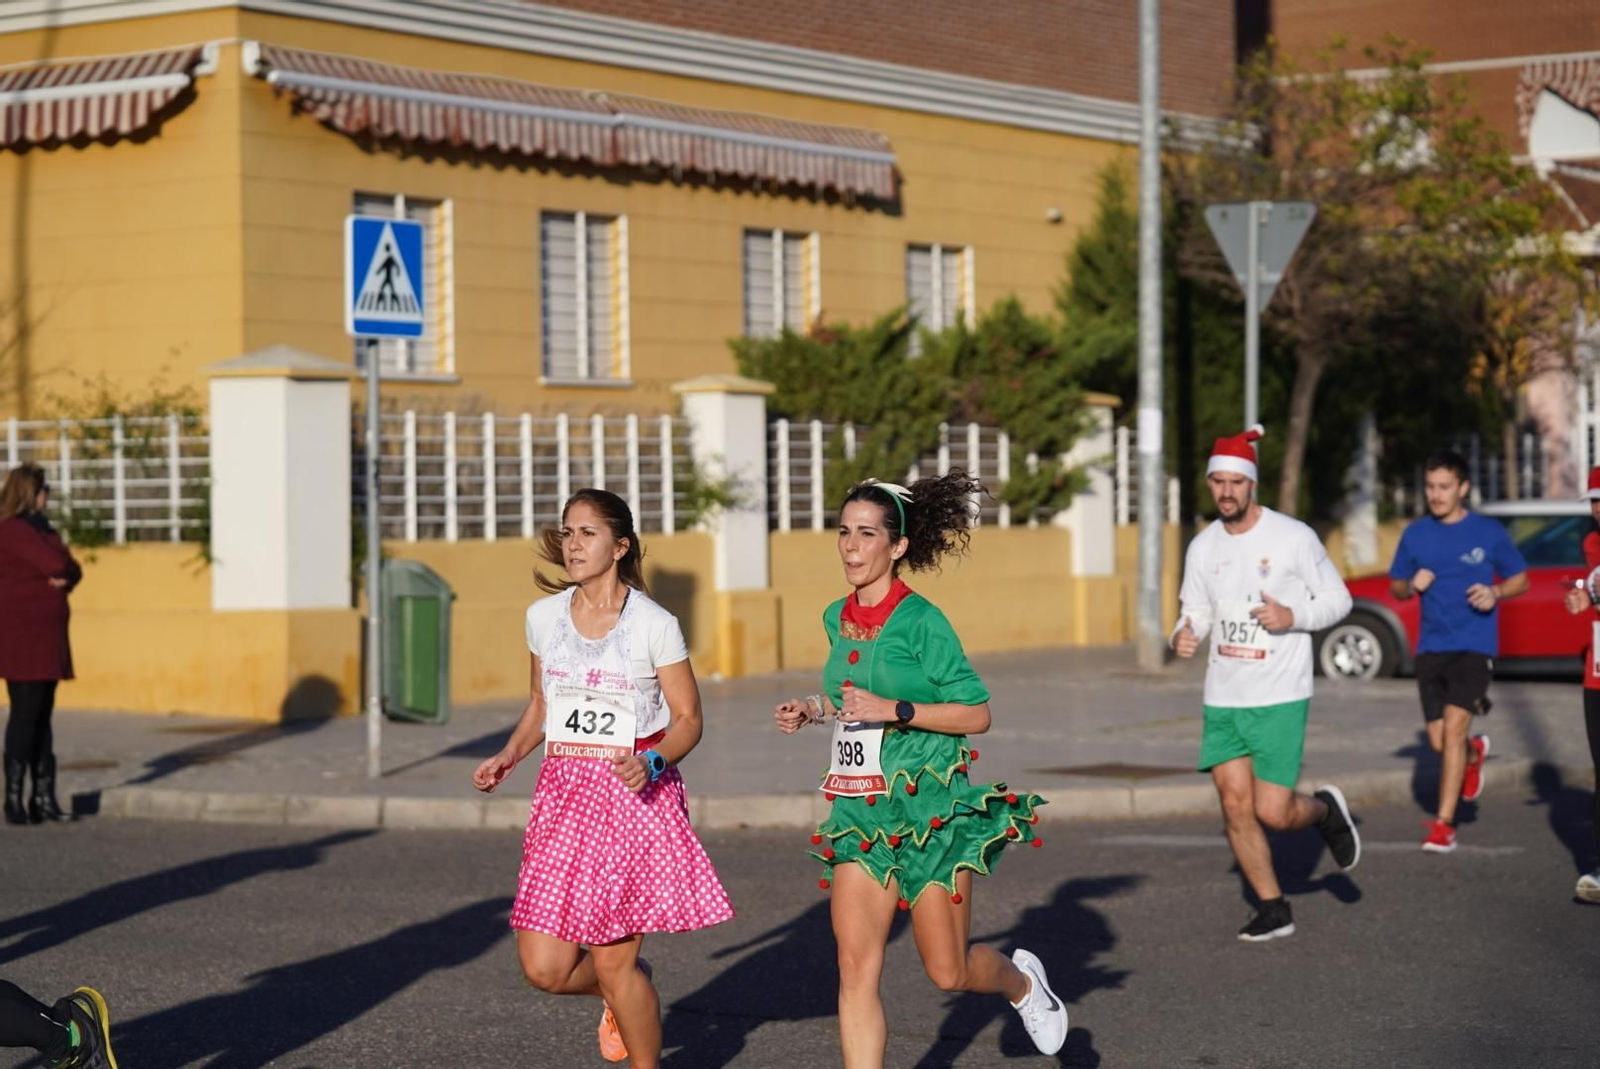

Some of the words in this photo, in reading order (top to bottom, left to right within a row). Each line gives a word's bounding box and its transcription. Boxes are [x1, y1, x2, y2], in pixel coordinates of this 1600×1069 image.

[1221, 619, 1260, 643] 1257
[565, 709, 616, 736] 432
[553, 742, 615, 760] Cruzcampo
[838, 740, 865, 767] 398
